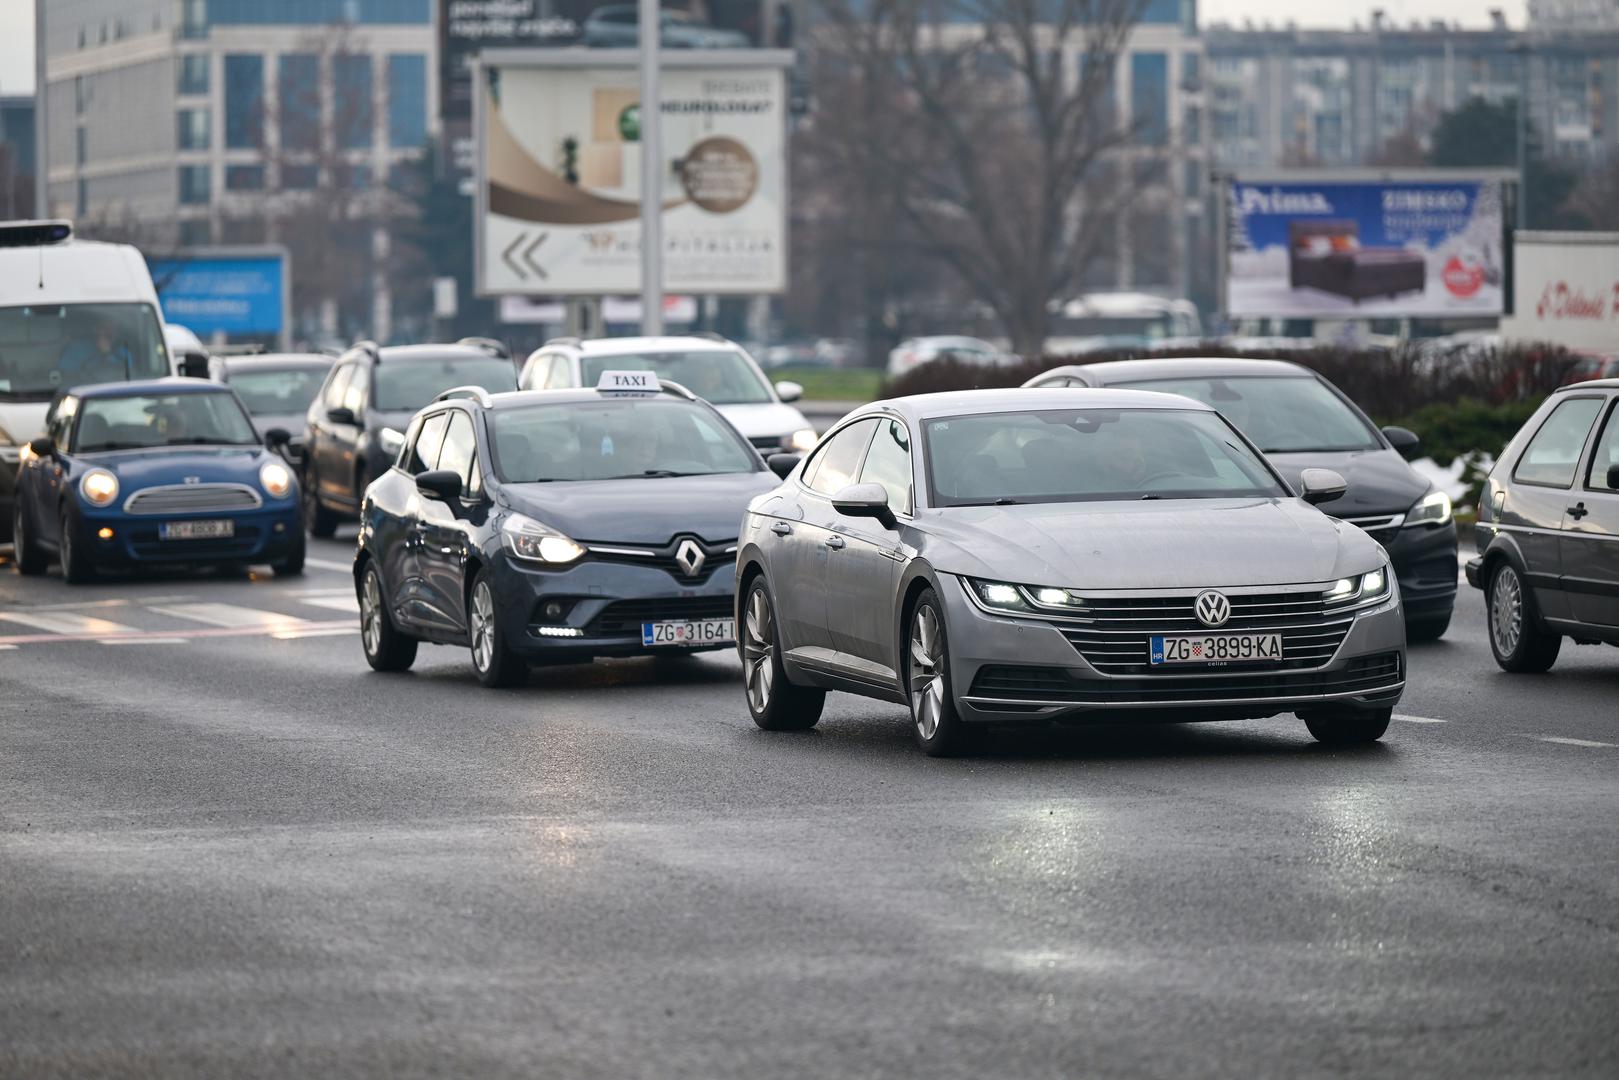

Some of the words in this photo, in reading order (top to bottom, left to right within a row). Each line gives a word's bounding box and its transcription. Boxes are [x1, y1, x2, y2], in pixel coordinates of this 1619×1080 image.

[612, 375, 646, 386] TAXI
[654, 624, 675, 642] ZG
[1165, 639, 1190, 660] ZG
